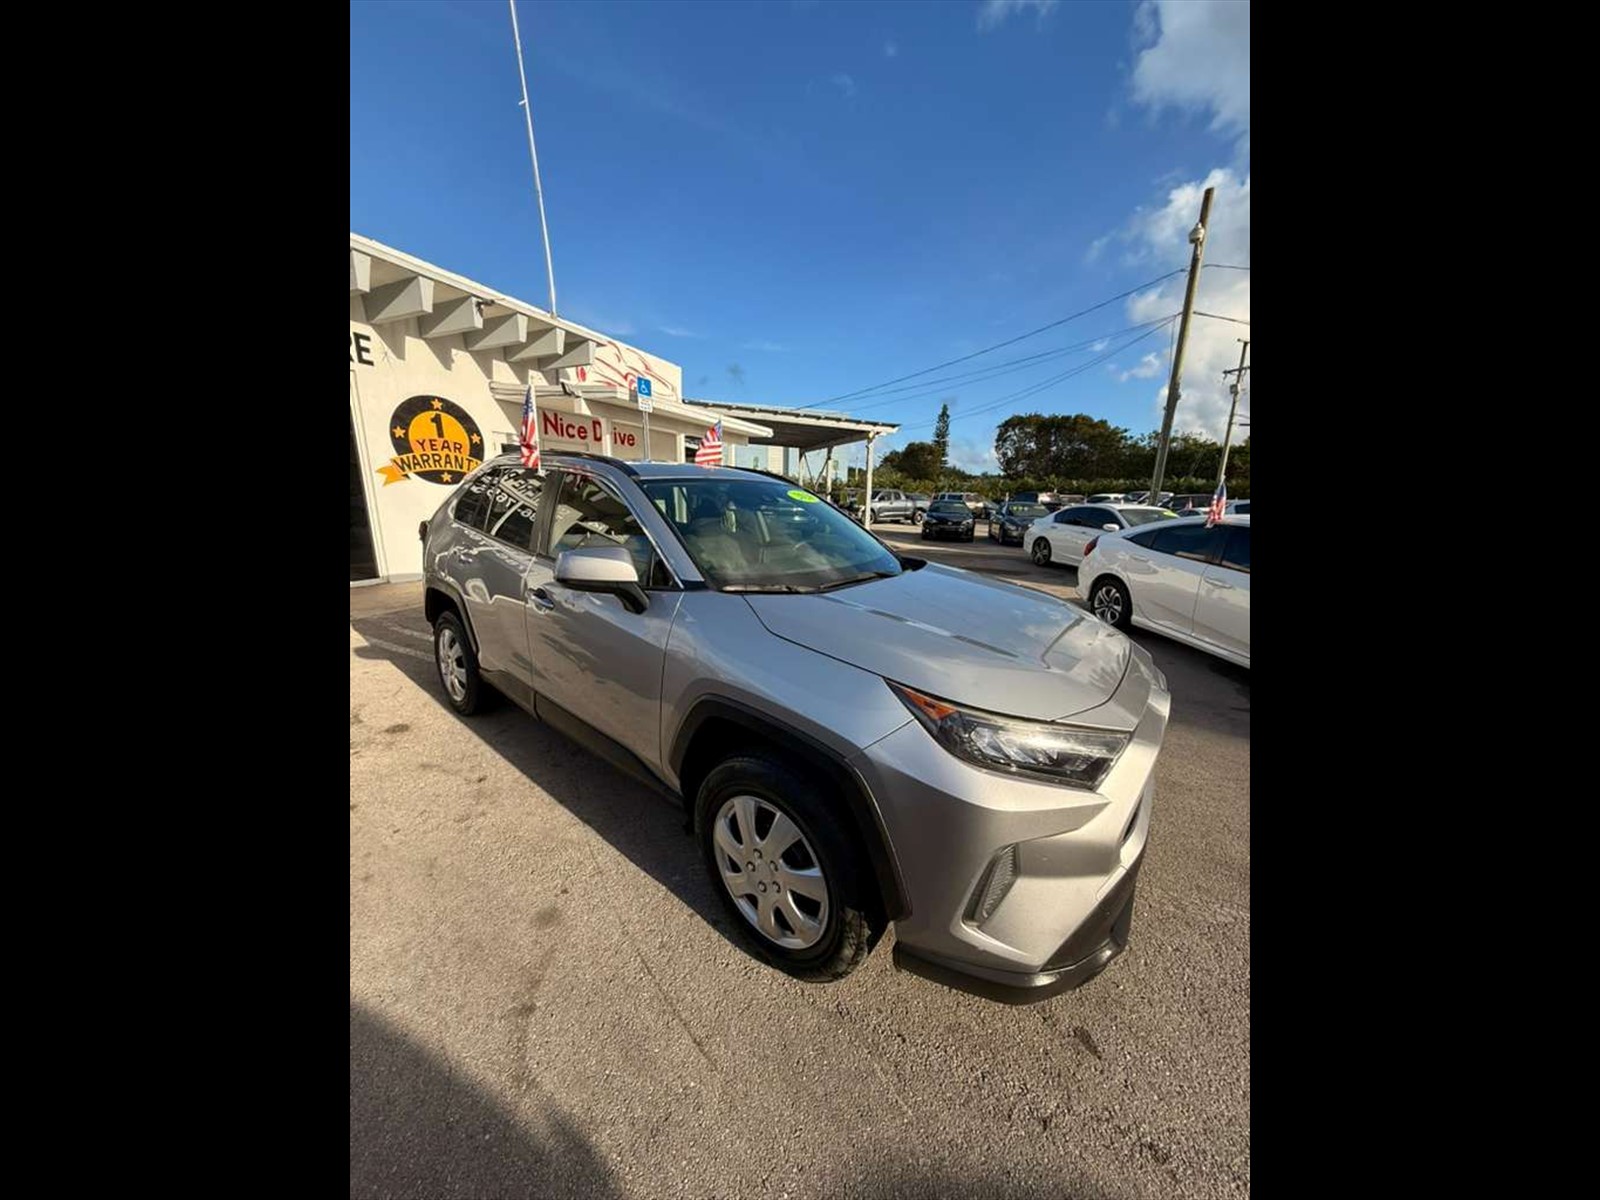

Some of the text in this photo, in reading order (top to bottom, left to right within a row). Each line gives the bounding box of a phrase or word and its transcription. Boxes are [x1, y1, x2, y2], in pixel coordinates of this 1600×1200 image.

[430, 413, 444, 438] 1
[542, 411, 635, 447] Nice Dive
[416, 439, 463, 454] YEAR
